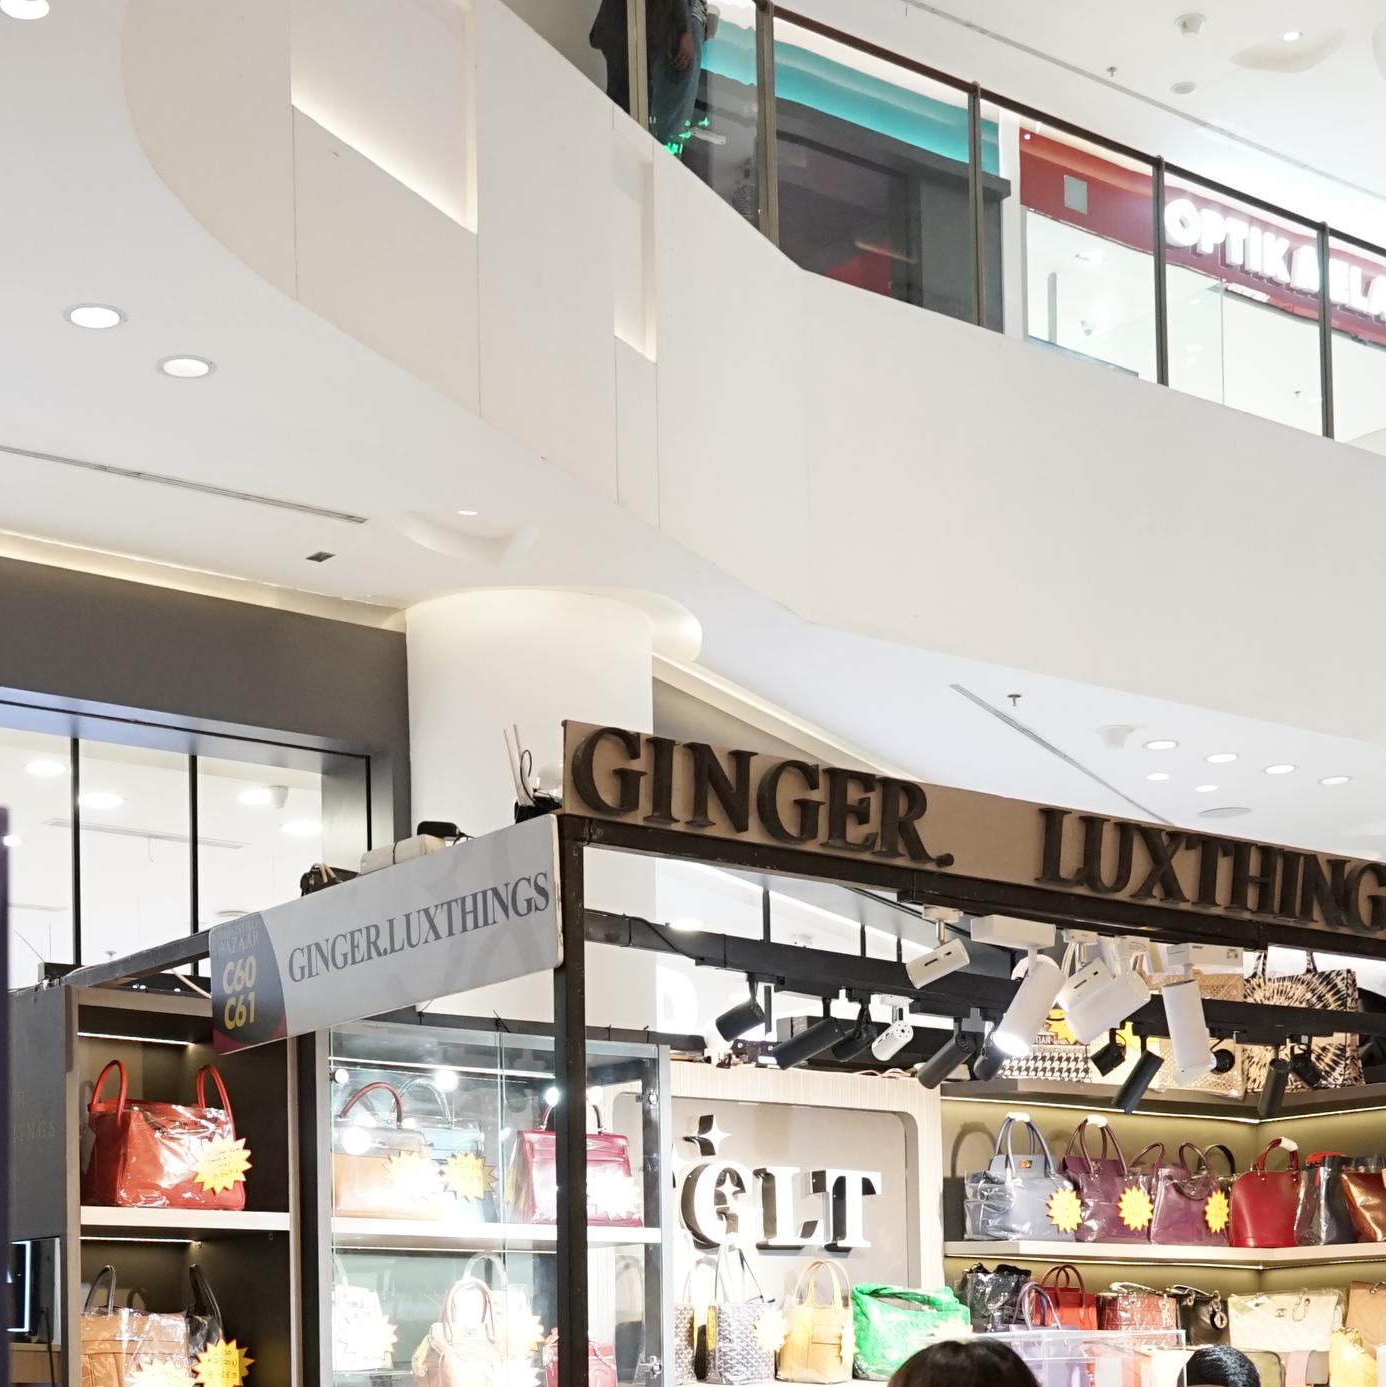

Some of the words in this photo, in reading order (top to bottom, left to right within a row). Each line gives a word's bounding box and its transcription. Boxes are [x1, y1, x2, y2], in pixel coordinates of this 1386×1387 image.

[1164, 198, 1291, 284] OPTIK
[223, 955, 256, 994] C60
[224, 991, 255, 1030] C61
[680, 1160, 882, 1253] GLT
